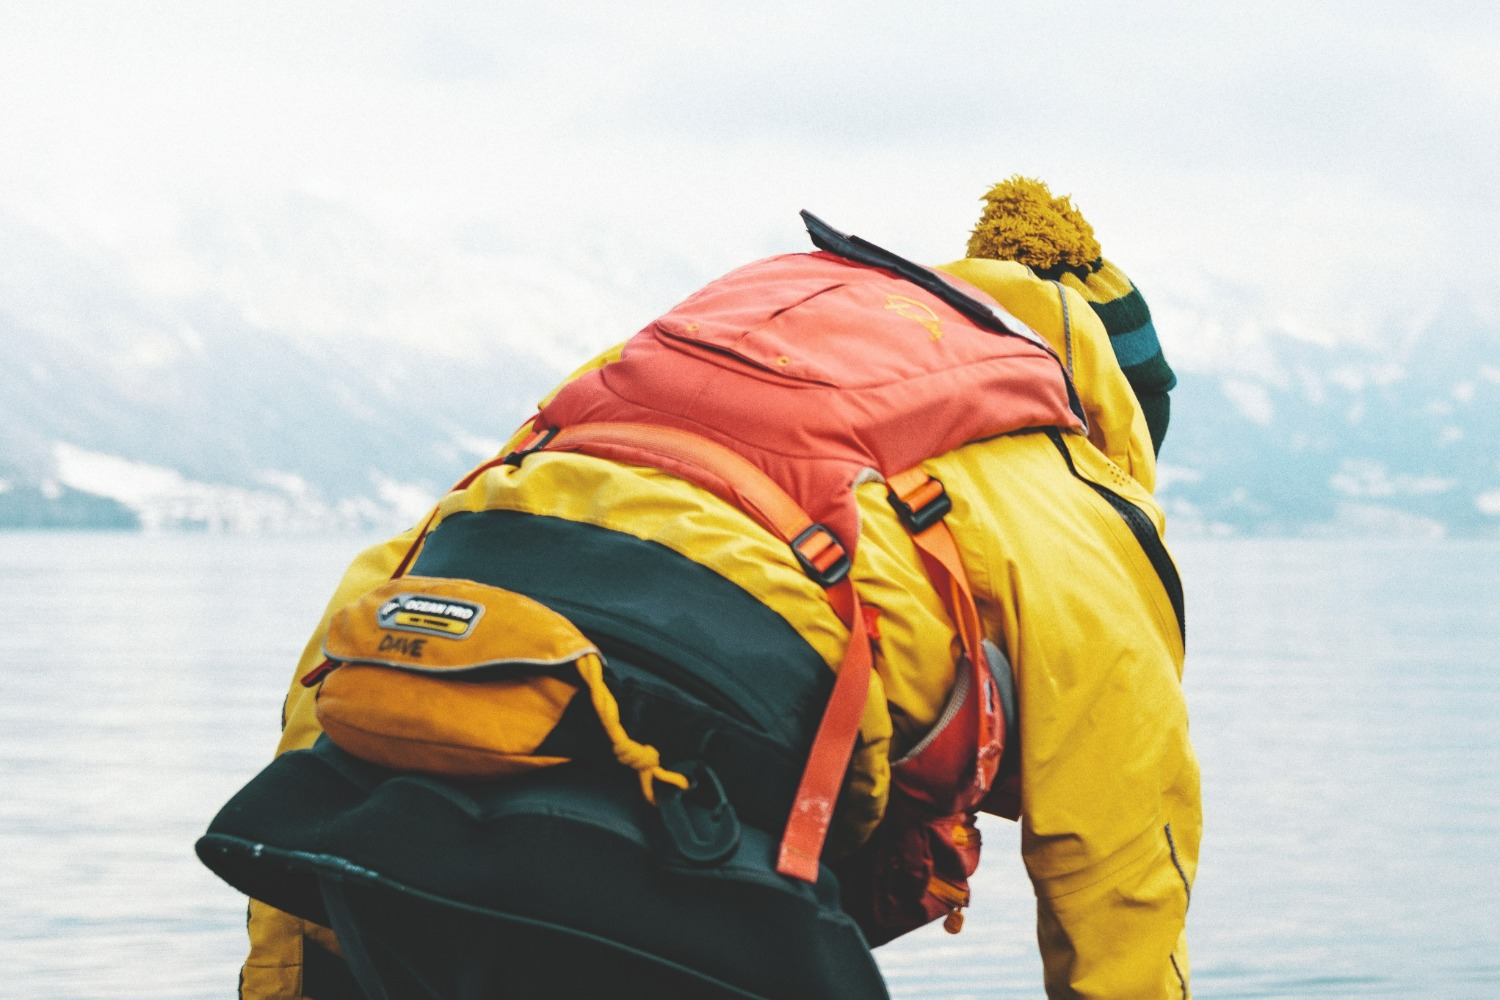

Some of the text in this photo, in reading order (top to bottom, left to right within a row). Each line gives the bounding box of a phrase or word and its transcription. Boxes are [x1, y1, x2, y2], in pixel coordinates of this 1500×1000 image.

[404, 600, 447, 615] OCEAN
[444, 604, 474, 620] PRO
[377, 634, 428, 658] DAVE
